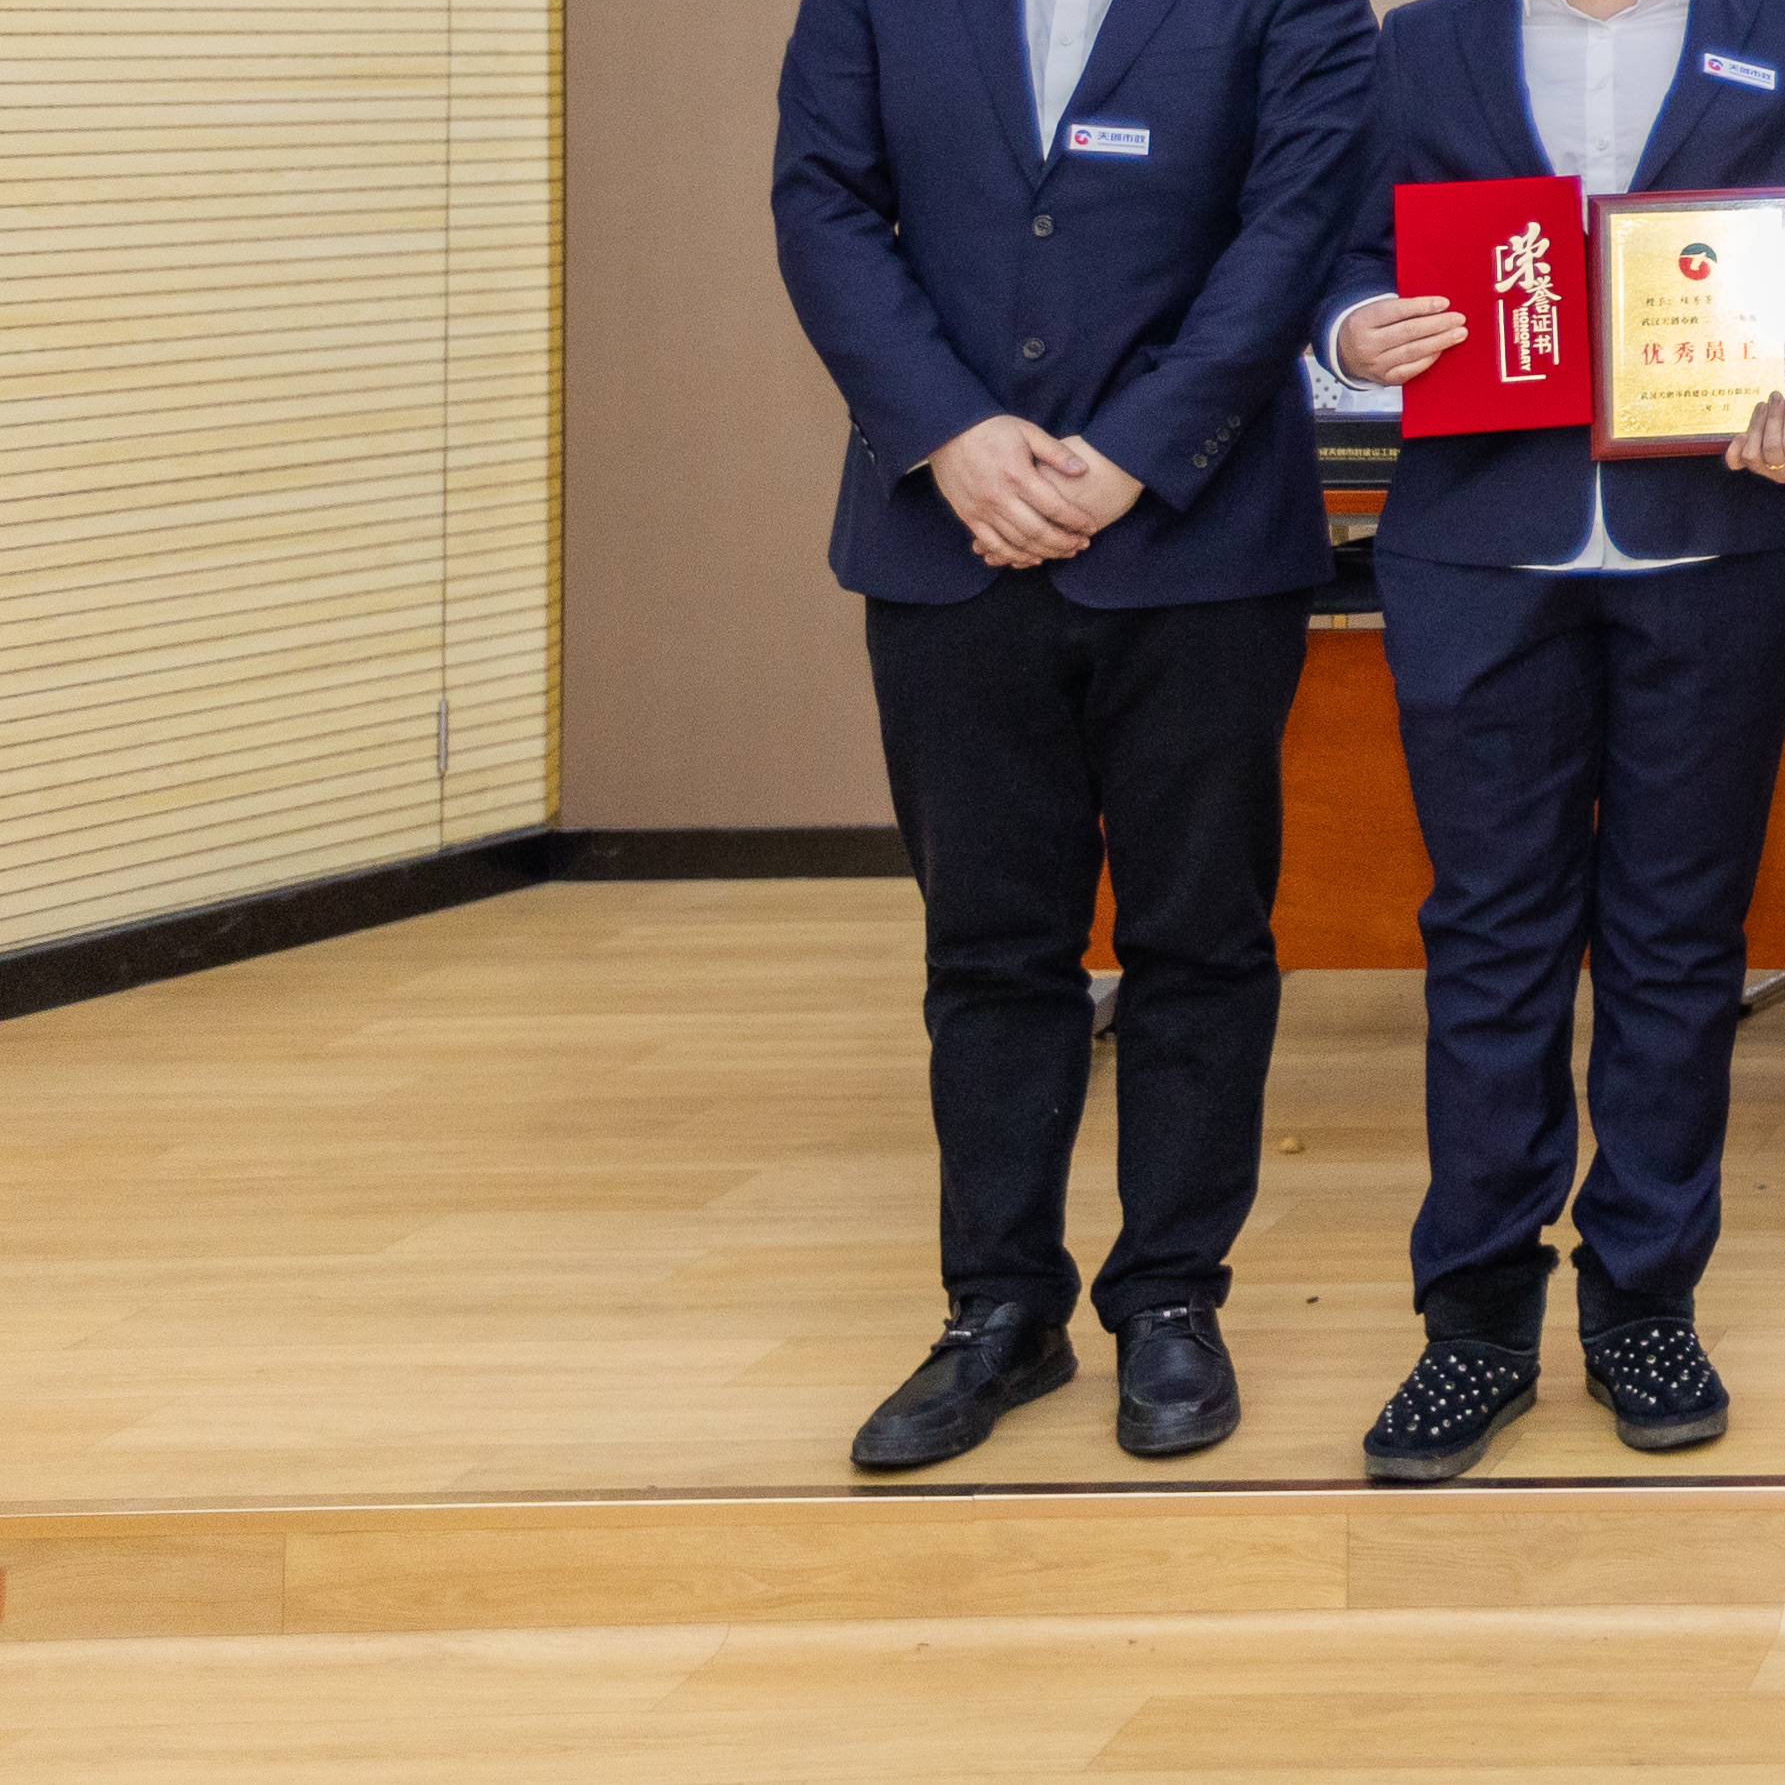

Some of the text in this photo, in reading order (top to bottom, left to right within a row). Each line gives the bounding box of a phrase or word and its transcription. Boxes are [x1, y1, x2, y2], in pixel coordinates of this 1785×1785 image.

[1494, 221, 1562, 355] 荣誉证书
[1519, 306, 1532, 372] HONORARY
[1641, 340, 1757, 366] 优秀员工
